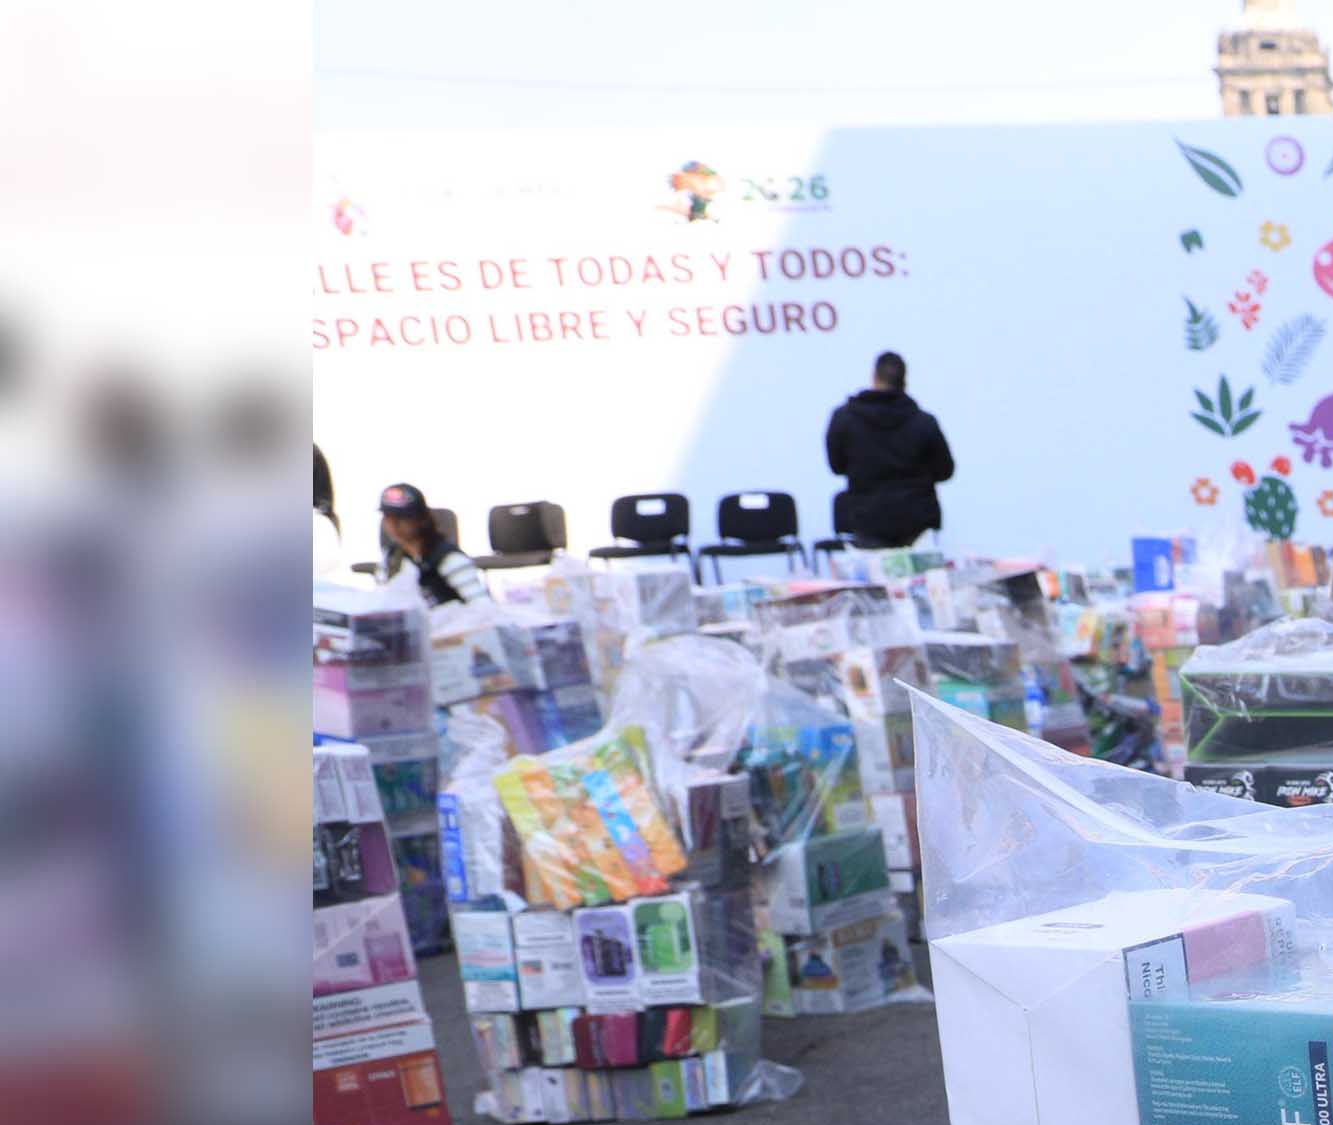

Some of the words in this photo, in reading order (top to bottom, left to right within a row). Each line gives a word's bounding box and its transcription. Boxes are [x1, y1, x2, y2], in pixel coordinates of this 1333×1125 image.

[314, 262, 394, 293] LLE
[411, 261, 462, 291] ES
[480, 259, 531, 289] DE
[547, 253, 694, 287] TODAS
[710, 251, 731, 281] Y
[752, 246, 910, 281] TODOS:
[313, 315, 472, 350] SPACIO
[489, 311, 610, 343] LIBRE
[626, 309, 646, 336] Y
[668, 301, 838, 337] SEGURO
[1314, 1061, 1331, 1105] ULTRA
